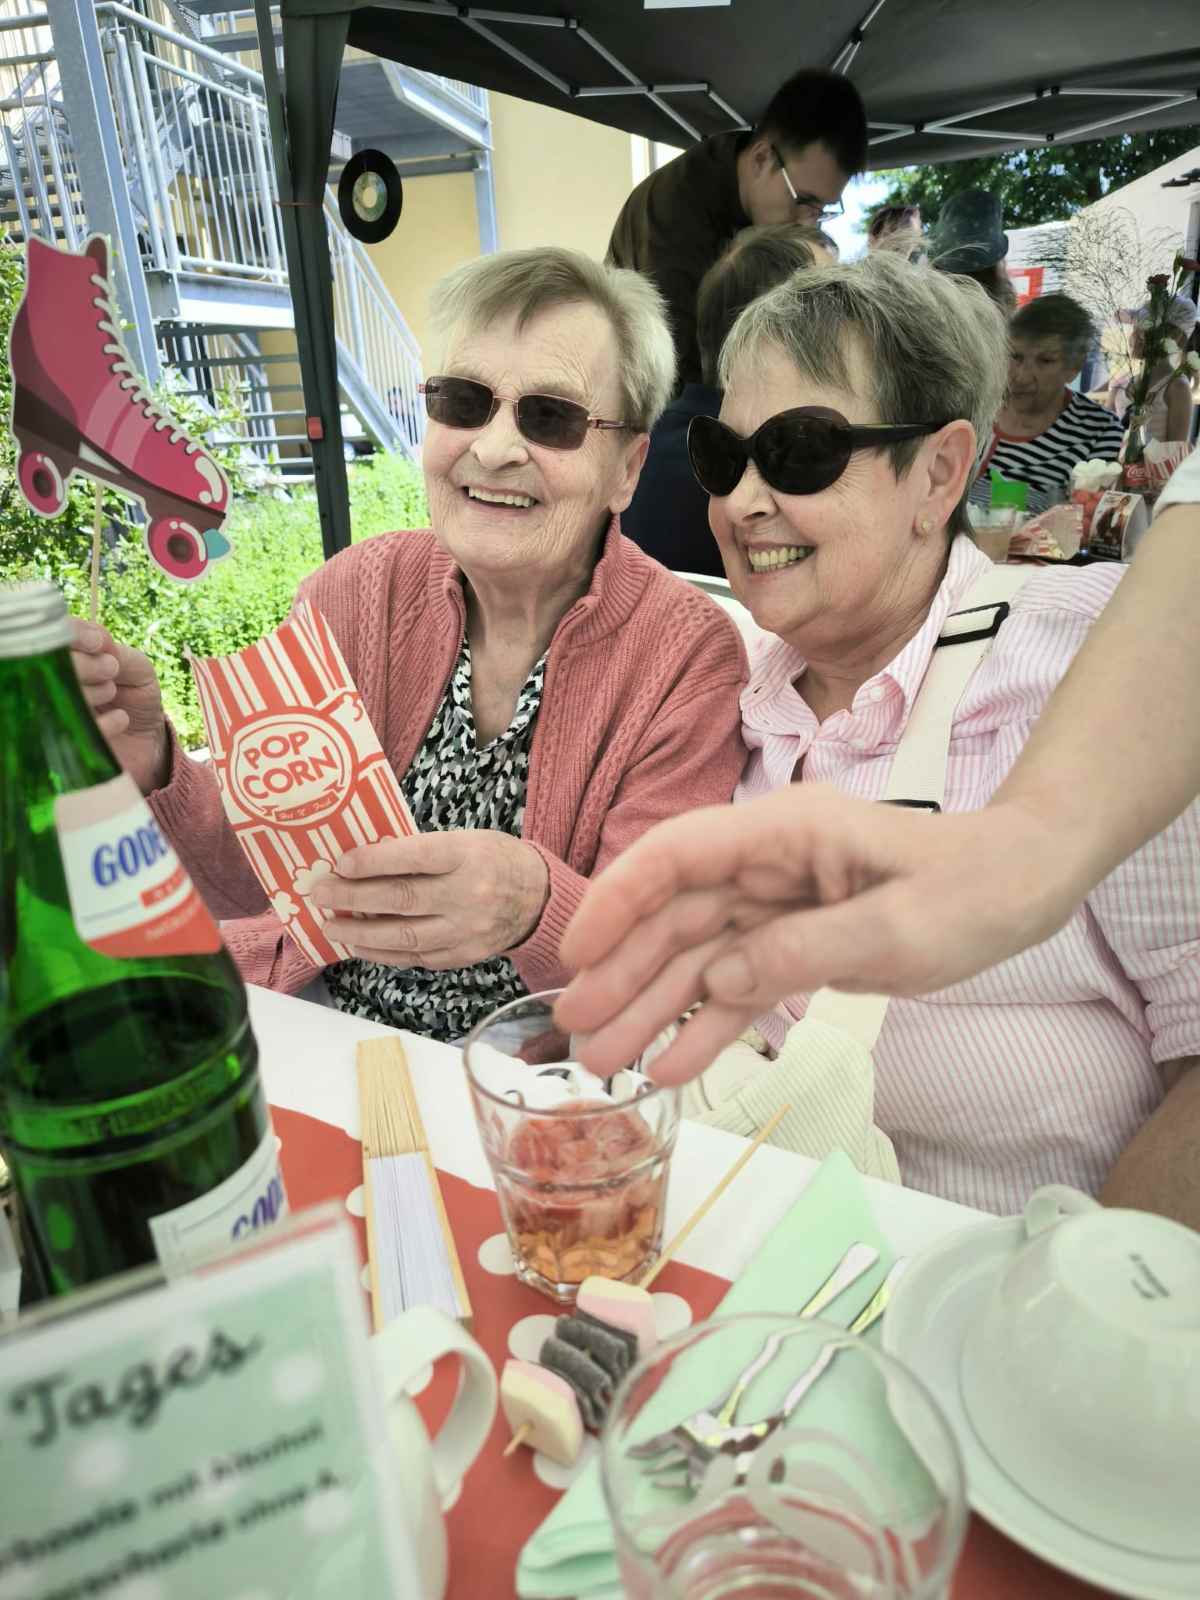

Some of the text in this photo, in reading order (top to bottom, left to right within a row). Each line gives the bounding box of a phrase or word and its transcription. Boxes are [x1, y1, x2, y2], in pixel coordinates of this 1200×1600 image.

[242, 746, 338, 799] CORN
[243, 731, 309, 769] POP
[10, 1329, 263, 1447] Tages
